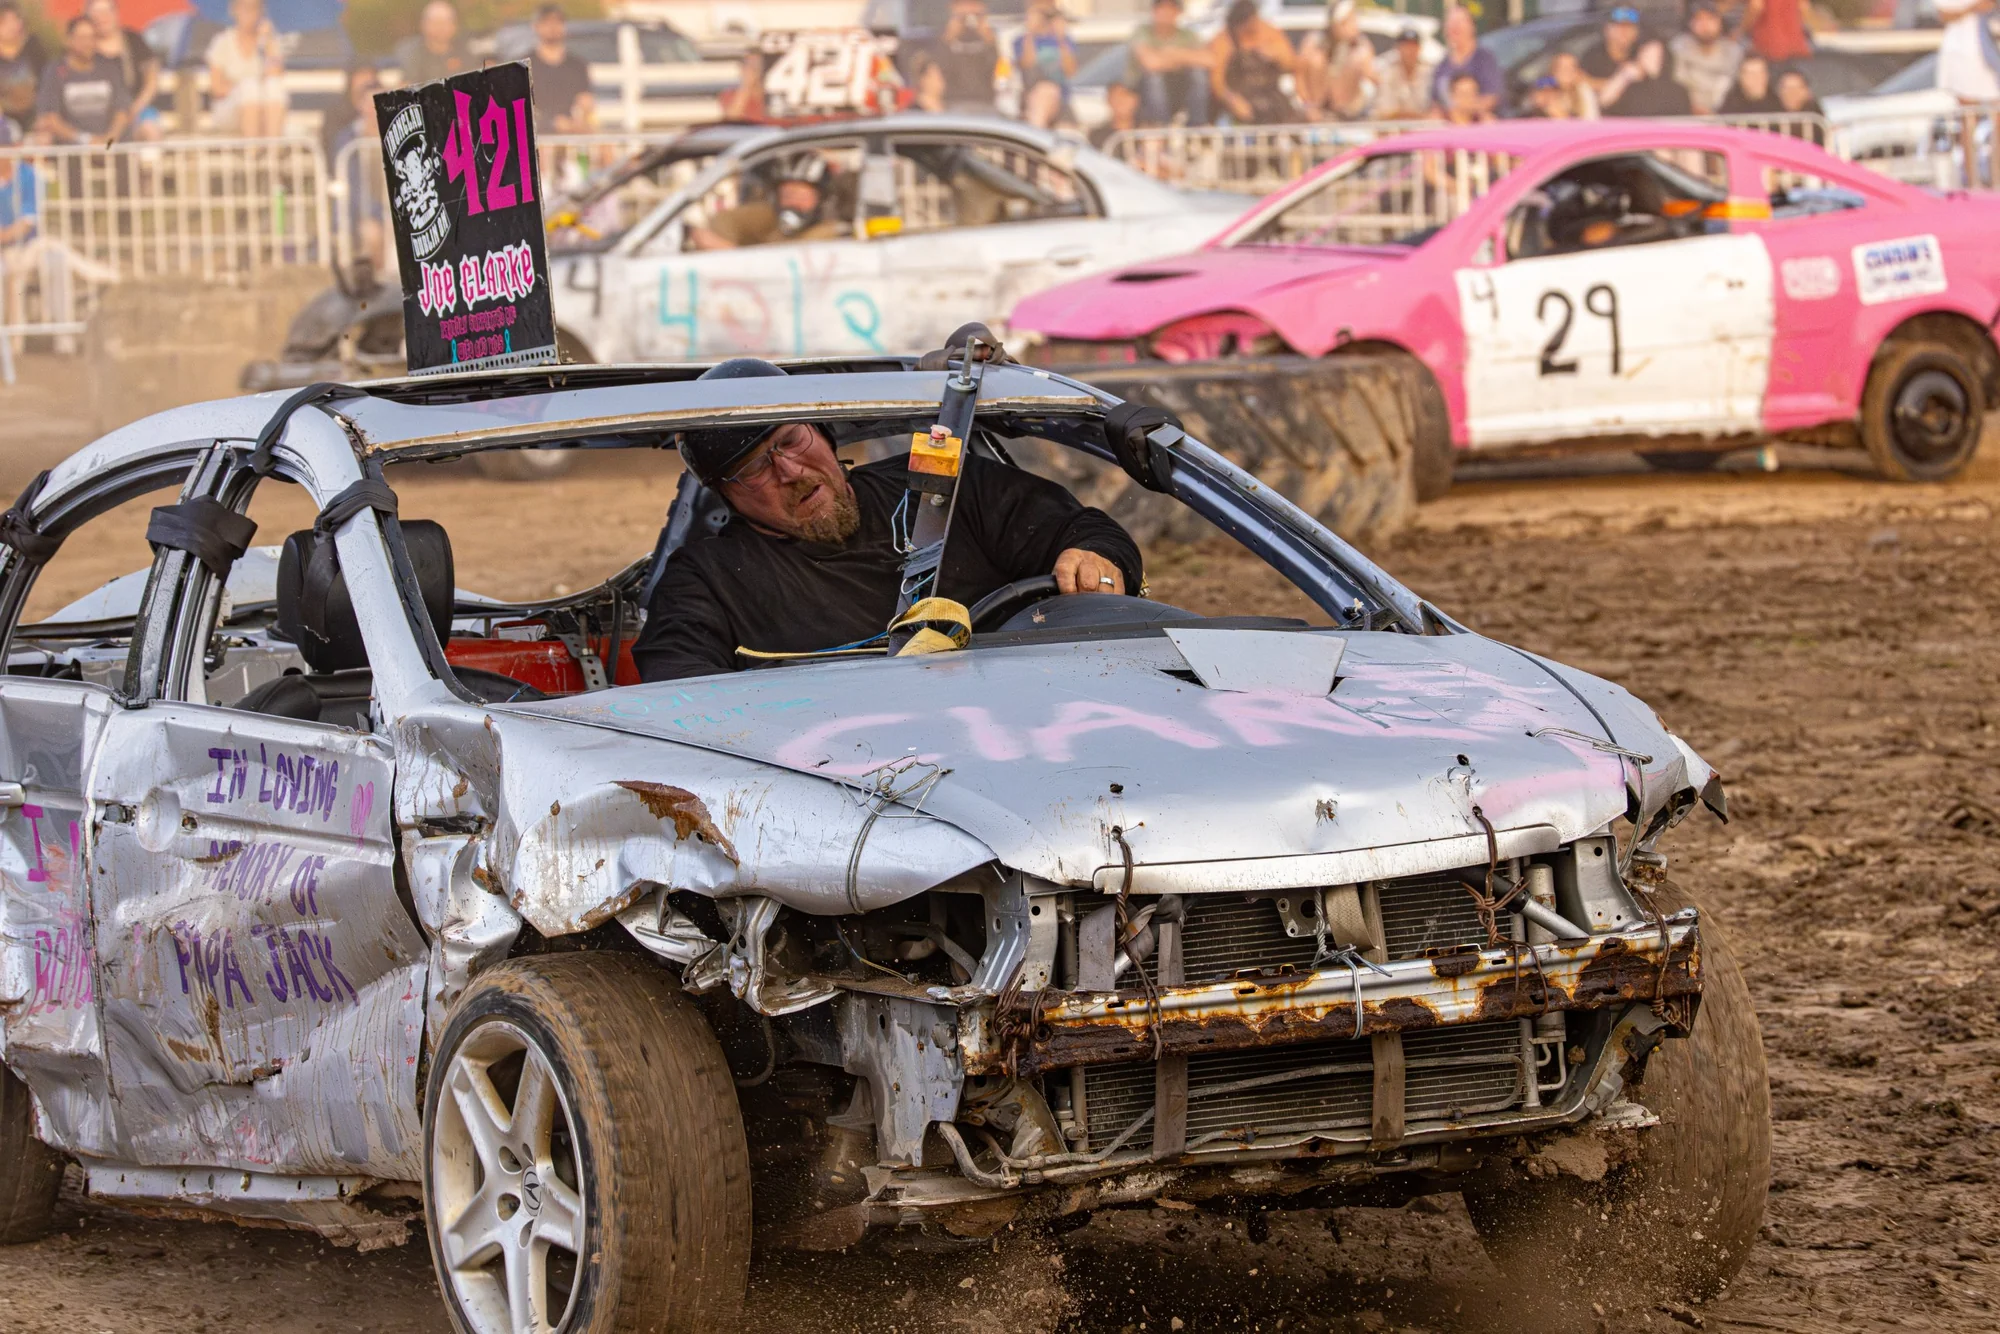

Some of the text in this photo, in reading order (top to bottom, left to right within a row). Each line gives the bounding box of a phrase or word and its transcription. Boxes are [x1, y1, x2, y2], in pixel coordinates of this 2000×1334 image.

[763, 37, 873, 108] 421
[443, 89, 535, 216] 421
[418, 239, 535, 319] JOE CLARKE
[1471, 276, 1498, 320] 4
[1536, 282, 1622, 377] 29
[207, 742, 339, 822] IN LOVING
[290, 855, 326, 917] OF
[251, 922, 360, 1007] JACK
